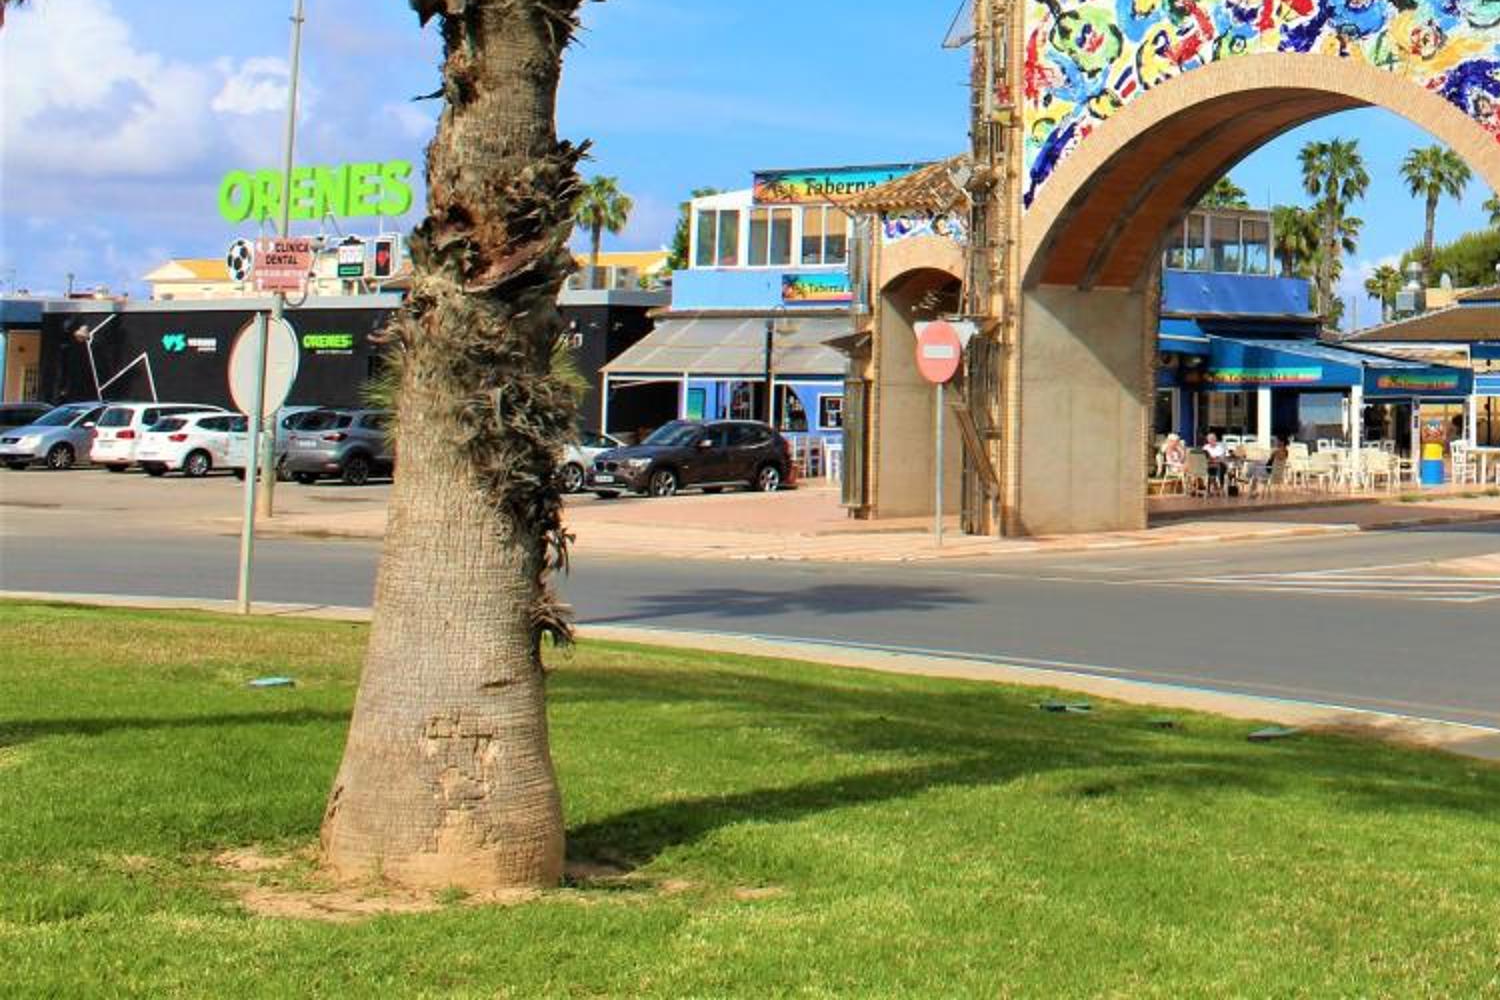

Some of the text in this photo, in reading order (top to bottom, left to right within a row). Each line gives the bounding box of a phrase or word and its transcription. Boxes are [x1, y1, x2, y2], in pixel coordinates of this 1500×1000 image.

[219, 159, 413, 223] ORENES
[804, 177, 877, 195] Taberna
[265, 254, 298, 264] DENTAL
[303, 334, 353, 348] ORENES
